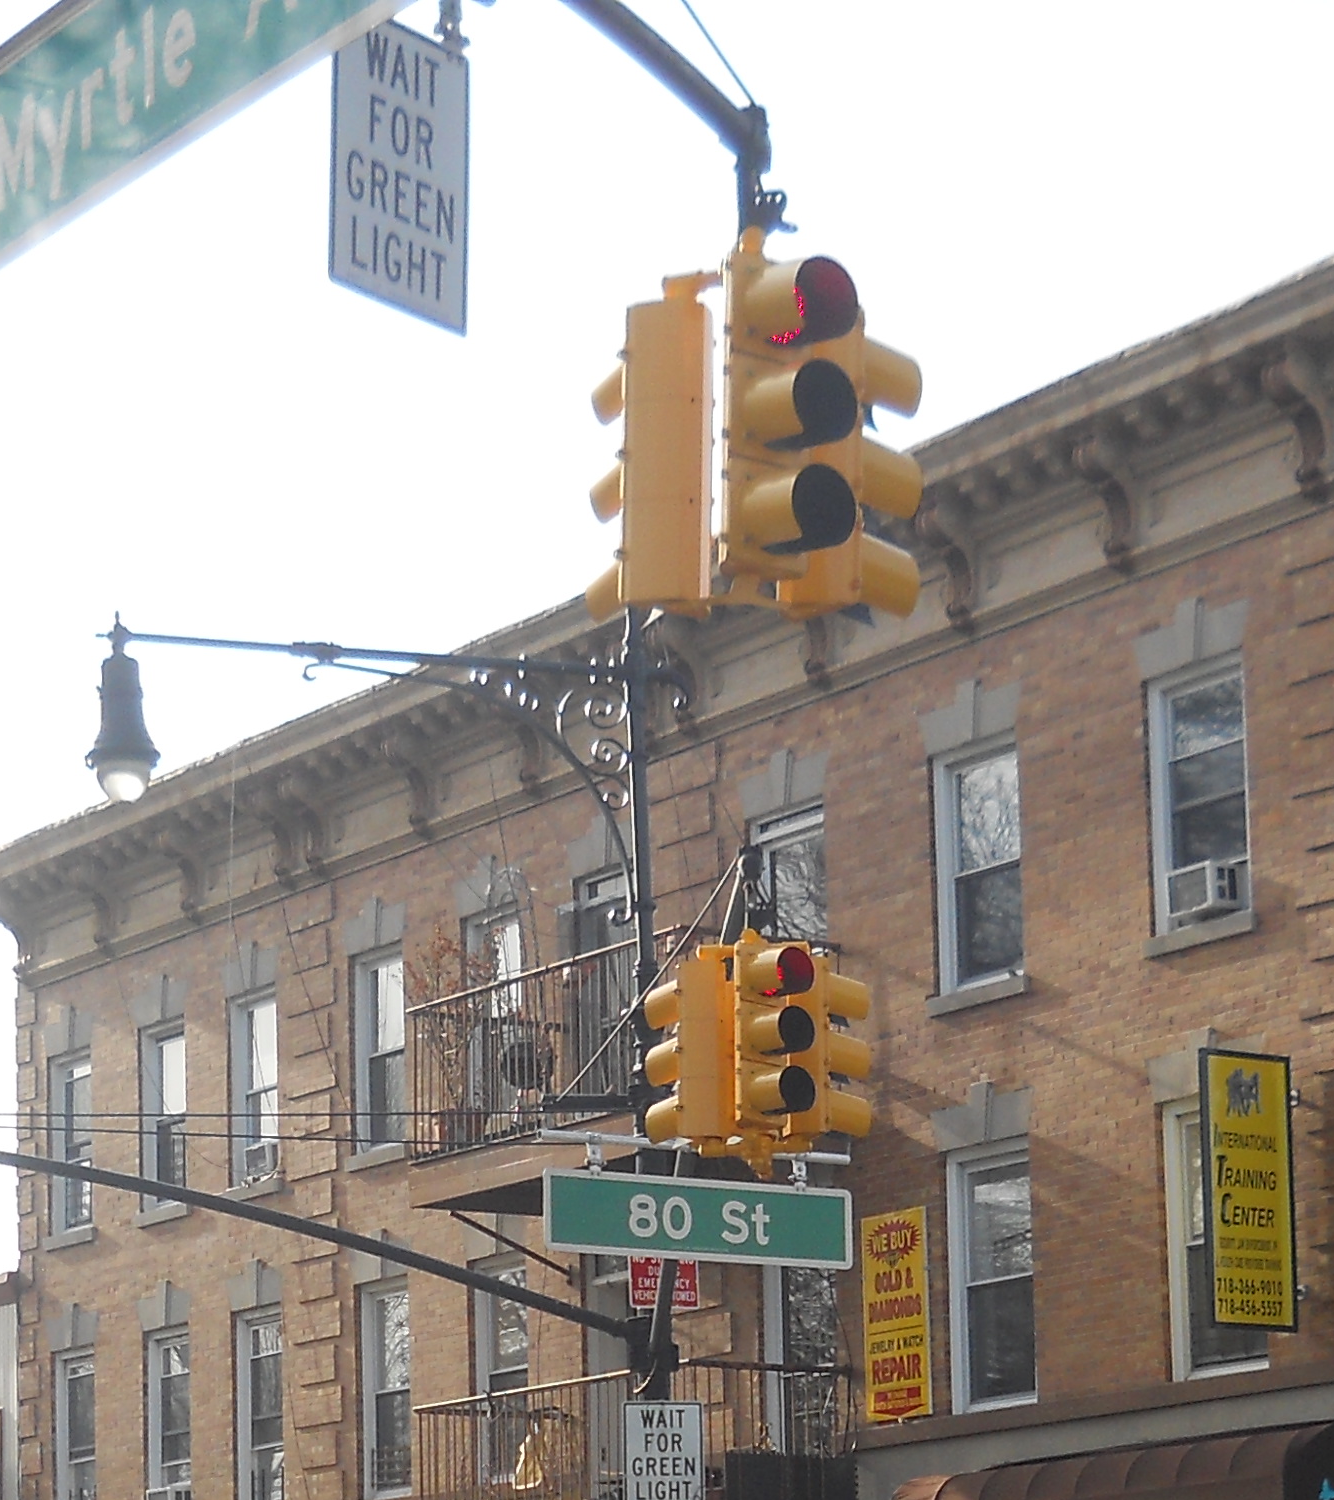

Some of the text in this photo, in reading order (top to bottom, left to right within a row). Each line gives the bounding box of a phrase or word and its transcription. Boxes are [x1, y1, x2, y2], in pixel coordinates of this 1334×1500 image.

[368, 32, 440, 107] WAIT
[369, 94, 434, 170] FOR
[346, 151, 455, 244] GREEN
[351, 215, 447, 301] LIGHT
[1213, 1123, 1278, 1153] INTERNATIONAL
[1216, 1154, 1277, 1191] TRAINING
[629, 1194, 771, 1246] 80 St
[1220, 1192, 1275, 1229] CENTER
[890, 1228, 913, 1250] BUY
[872, 1353, 923, 1386] REPAIR
[641, 1409, 685, 1429] WAIT
[644, 1433, 683, 1453] FOR
[632, 1457, 697, 1477] GREEN
[636, 1480, 692, 1500] LIGHT
